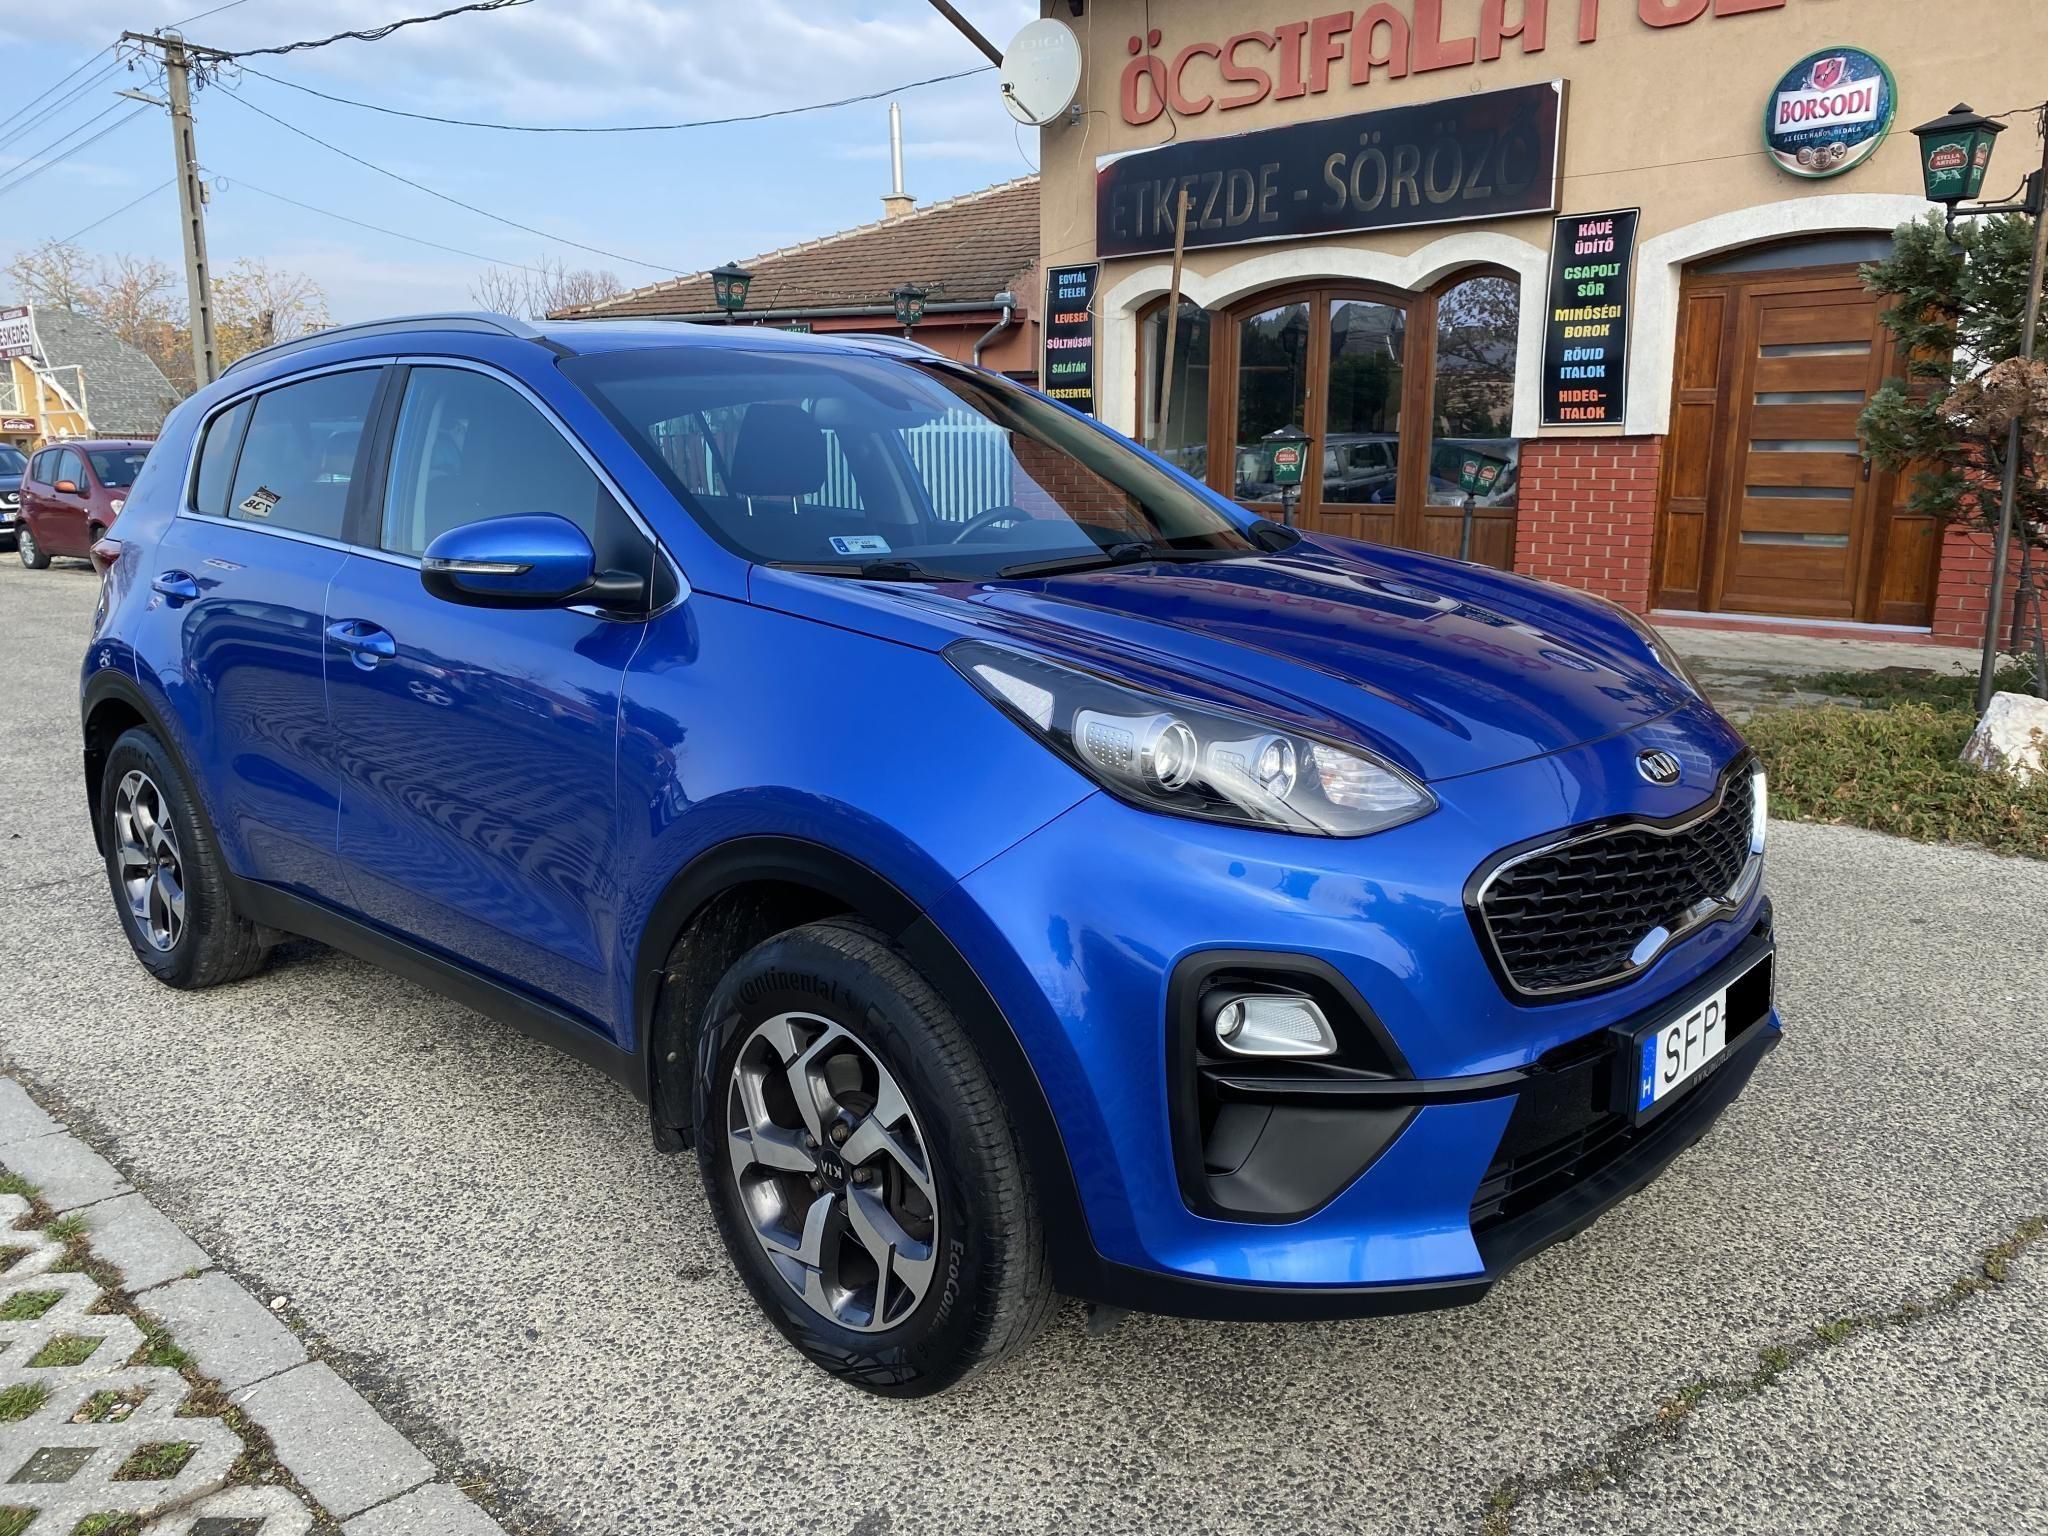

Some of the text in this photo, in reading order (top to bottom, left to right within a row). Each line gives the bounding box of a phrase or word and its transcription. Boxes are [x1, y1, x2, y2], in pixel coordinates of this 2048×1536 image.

[1120, 0, 1787, 125] ÖCSIFALA
[1779, 87, 1873, 125] BORSODI
[1935, 153, 1961, 161] STELLA
[1578, 220, 1614, 237] KÁVÉ
[1574, 237, 1615, 255] ÜDÍTŐ
[1058, 272, 1087, 285] EGYTÁL
[1564, 263, 1621, 280] CSAPOLT
[1058, 286, 1087, 299] ÉTELEK
[1577, 282, 1605, 297] SÖR
[1054, 311, 1089, 324] LEVESEK
[1554, 304, 1622, 321] MINŐSÉGI
[1564, 323, 1611, 339] BOROK
[1046, 336, 1092, 350] SÜLTHÚSOK
[1563, 347, 1605, 362] RÖVID
[1051, 361, 1087, 374] SALÁTÁK
[1560, 365, 1606, 379] ITALOK
[1558, 389, 1607, 402] HIDEG-
[1560, 406, 1606, 420] ITALOK
[739, 966, 838, 1006] Continental
[1642, 1076, 1652, 1099] H
